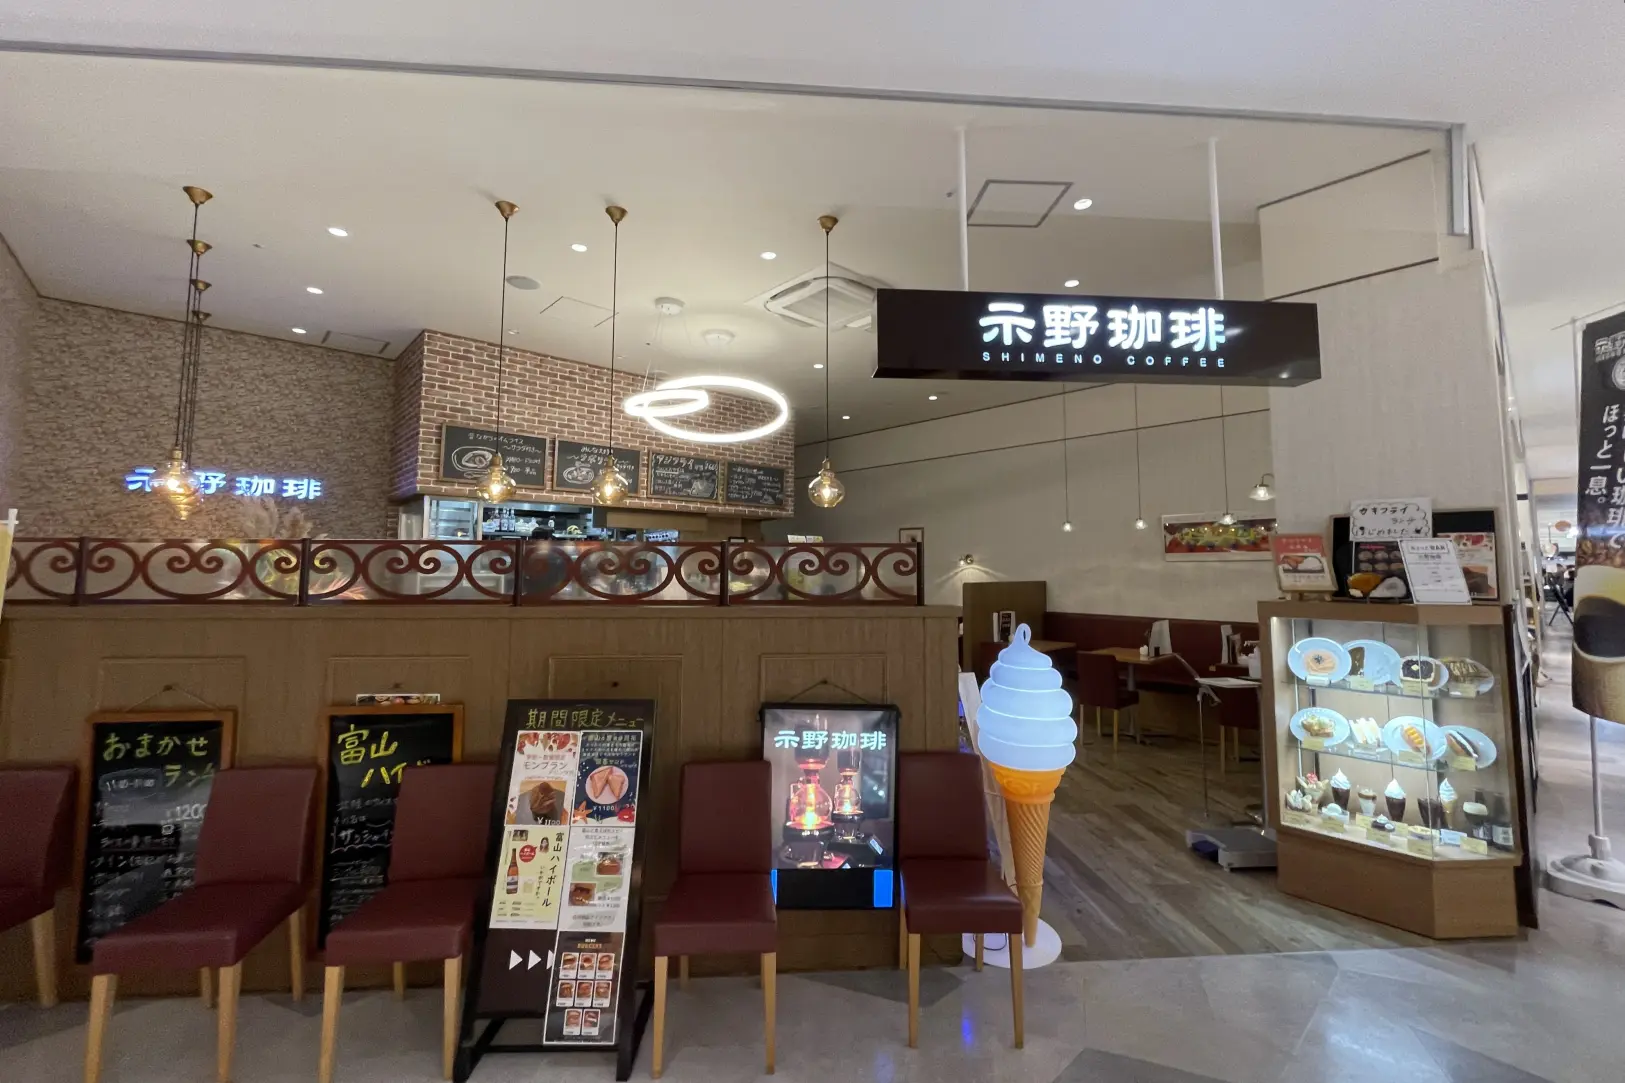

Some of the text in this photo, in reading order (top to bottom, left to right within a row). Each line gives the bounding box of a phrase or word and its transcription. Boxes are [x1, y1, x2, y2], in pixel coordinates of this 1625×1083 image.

[978, 302, 1226, 352] 示野珈琲
[982, 351, 1226, 368] SHIMENO COFFEE
[1585, 403, 1620, 504] ほっと一息。
[1359, 505, 1408, 516] カキフライ
[526, 708, 644, 729] 期間限定メニュー
[102, 732, 209, 762] おまかせ
[337, 723, 398, 765] 富山
[773, 730, 887, 750] 示野珈琲
[541, 832, 565, 907] 富山ハイボール
